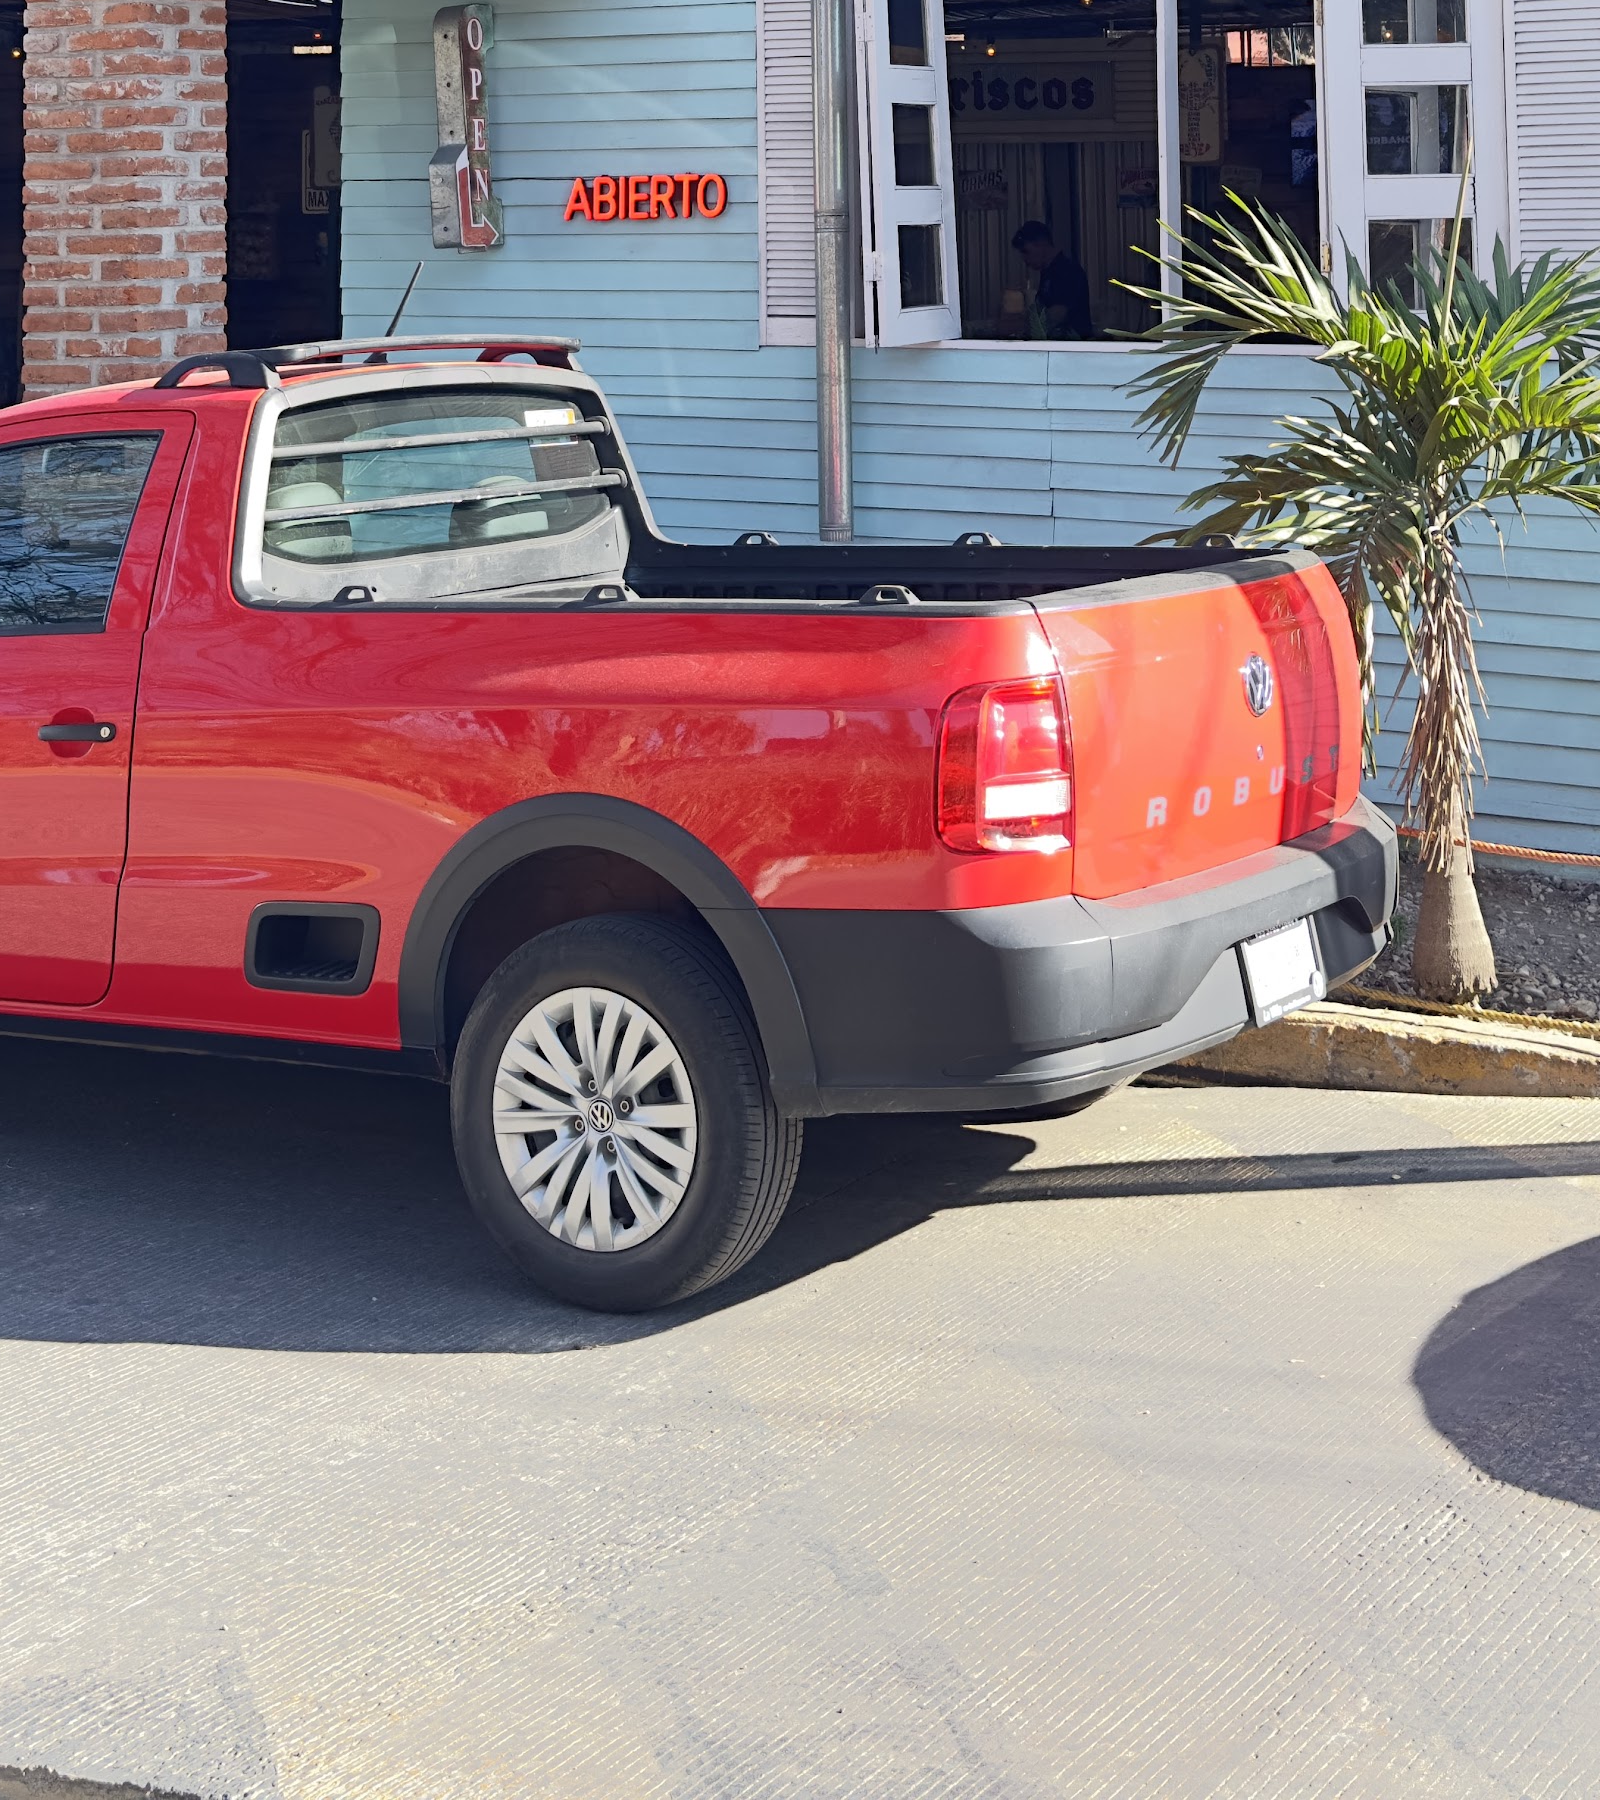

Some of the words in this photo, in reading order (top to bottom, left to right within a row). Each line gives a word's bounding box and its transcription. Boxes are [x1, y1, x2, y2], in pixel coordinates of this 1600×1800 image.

[466, 18, 490, 202] OPEN
[562, 173, 728, 222] ABIERTO
[1145, 744, 1340, 829] ROBUST
